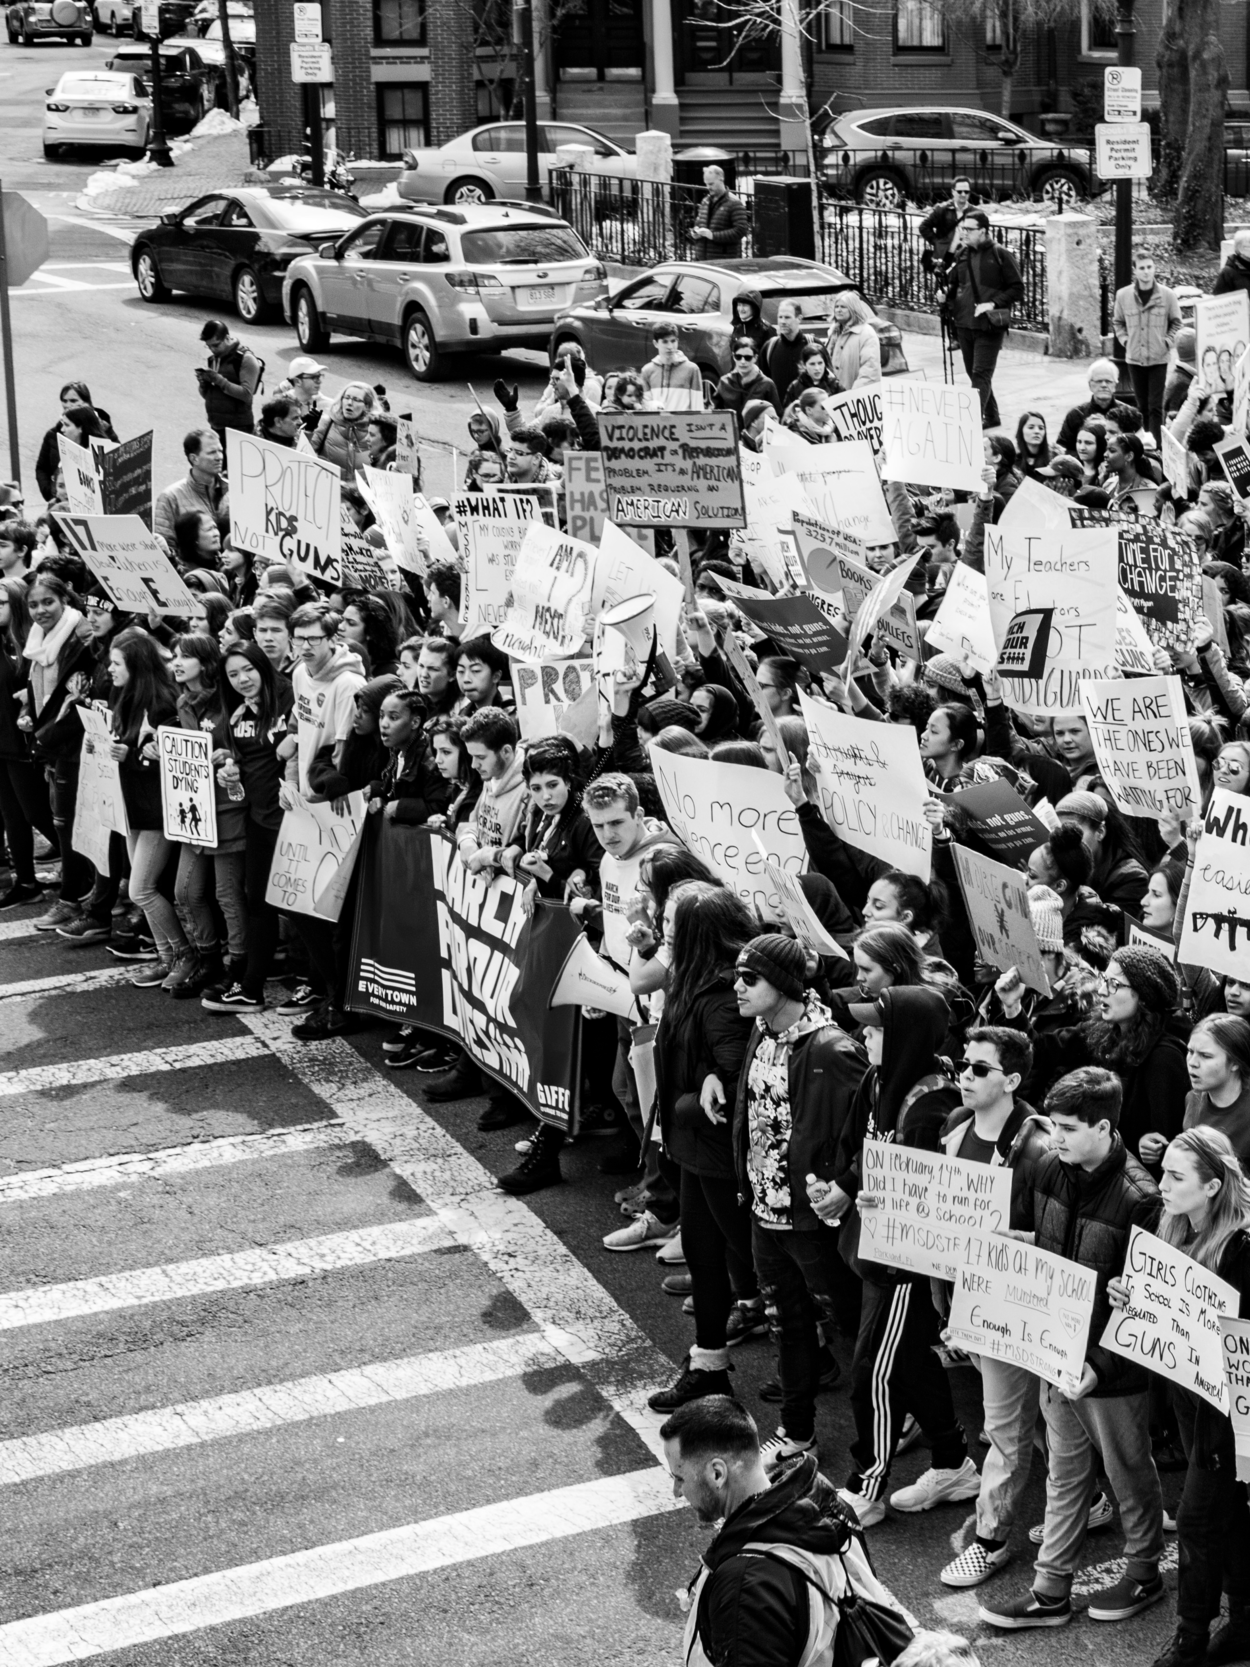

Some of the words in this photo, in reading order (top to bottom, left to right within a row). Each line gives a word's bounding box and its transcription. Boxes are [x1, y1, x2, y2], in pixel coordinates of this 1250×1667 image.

[1109, 155, 1137, 163] Parking
[1115, 163, 1131, 171] Only
[604, 425, 680, 442] VIOLENCE
[719, 423, 727, 433] A
[602, 446, 666, 461] DEMOCRAT
[678, 467, 688, 475] AN
[691, 461, 741, 483] AMERICAN
[240, 440, 339, 540] PROTECT
[455, 497, 508, 517] #WHAT
[514, 498, 534, 520] IF?
[615, 495, 689, 521] AMERICAN
[694, 501, 743, 520] SOLUTION
[233, 520, 273, 551] NOT
[279, 534, 341, 583] GUNS
[839, 560, 872, 591] BOOKS
[1090, 698, 1123, 723] WE
[1132, 694, 1171, 719] ARE
[164, 736, 208, 761] CAUTION
[1094, 727, 1125, 752] THE
[1127, 731, 1164, 752] ONES
[1169, 727, 1191, 749] WE
[168, 758, 210, 780] STUDENTS
[1103, 756, 1140, 778] HAVE
[1147, 758, 1186, 778] BEEN
[172, 775, 199, 794] DYING
[1114, 784, 1163, 812] WAITING
[1166, 788, 1196, 809] FOR
[280, 840, 311, 862] UNTIL
[288, 860, 302, 875] IT
[273, 875, 308, 893] COMES
[281, 890, 297, 906] TO
[358, 981, 417, 1007] EVERYTOWN
